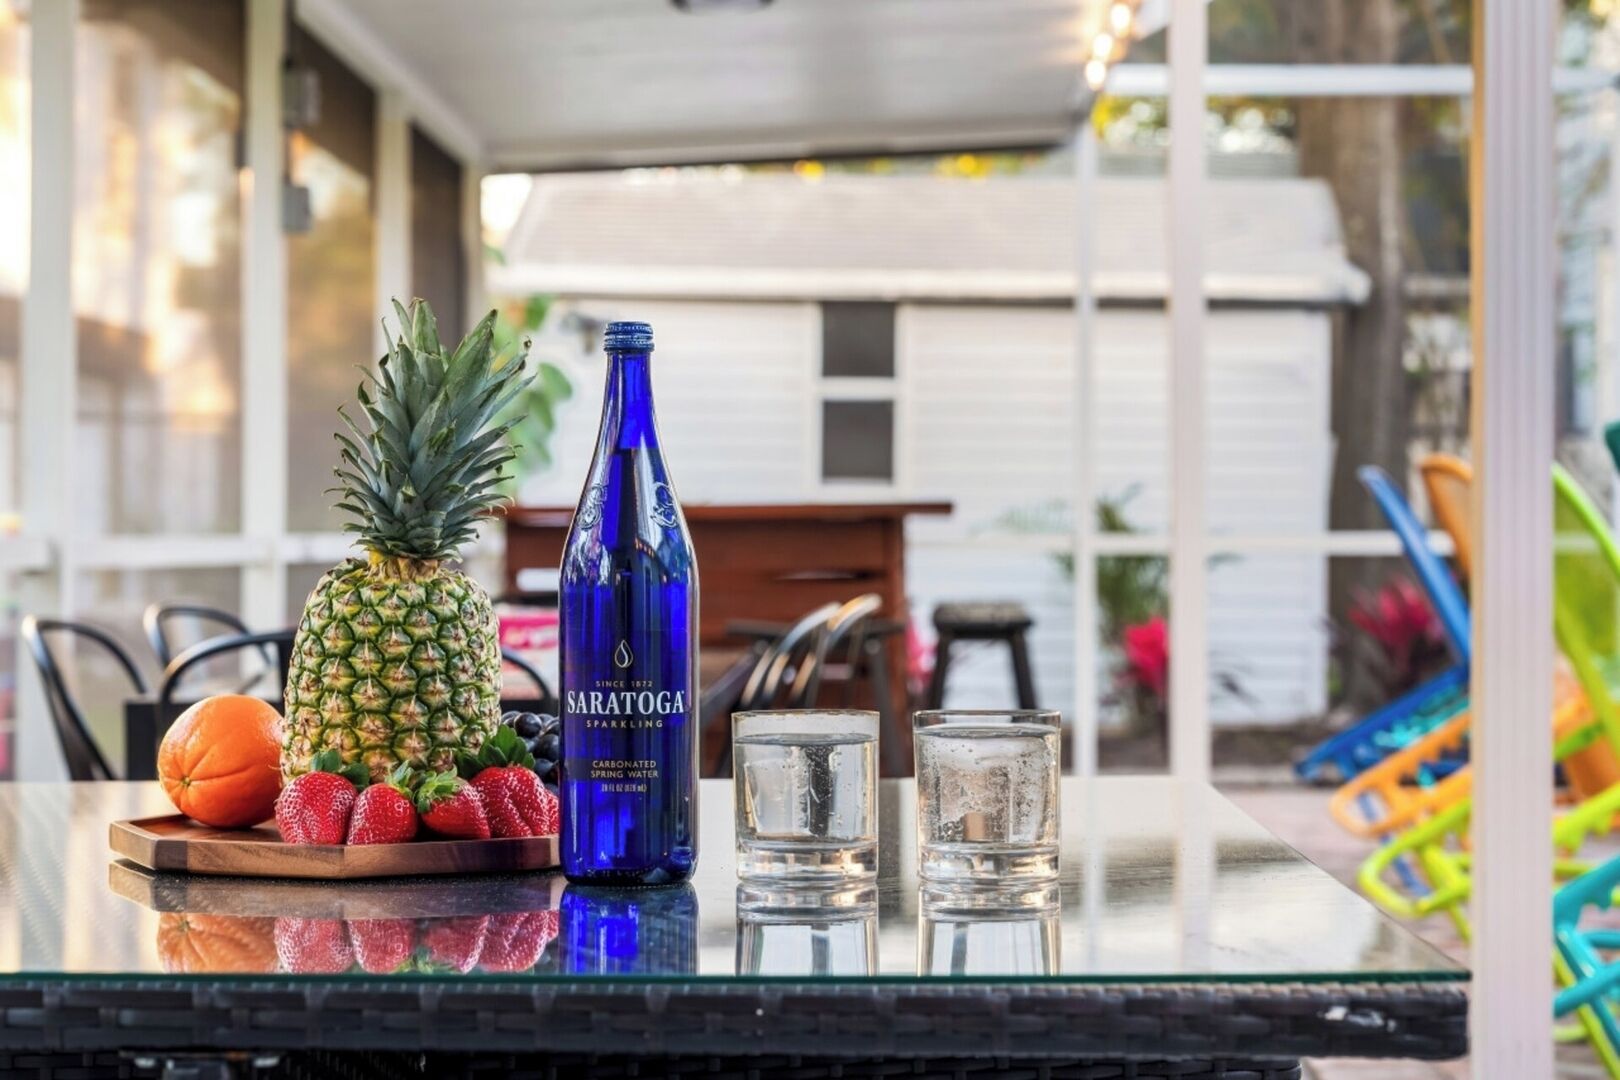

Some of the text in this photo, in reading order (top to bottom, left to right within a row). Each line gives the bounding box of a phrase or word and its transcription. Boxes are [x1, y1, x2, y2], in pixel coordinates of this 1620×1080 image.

[595, 680, 653, 688] SINCE 1872
[567, 690, 684, 715] SARATOGA
[586, 719, 663, 728] SPARKLING
[592, 761, 656, 769] CARBONATED
[590, 770, 659, 779] SPRING WATER
